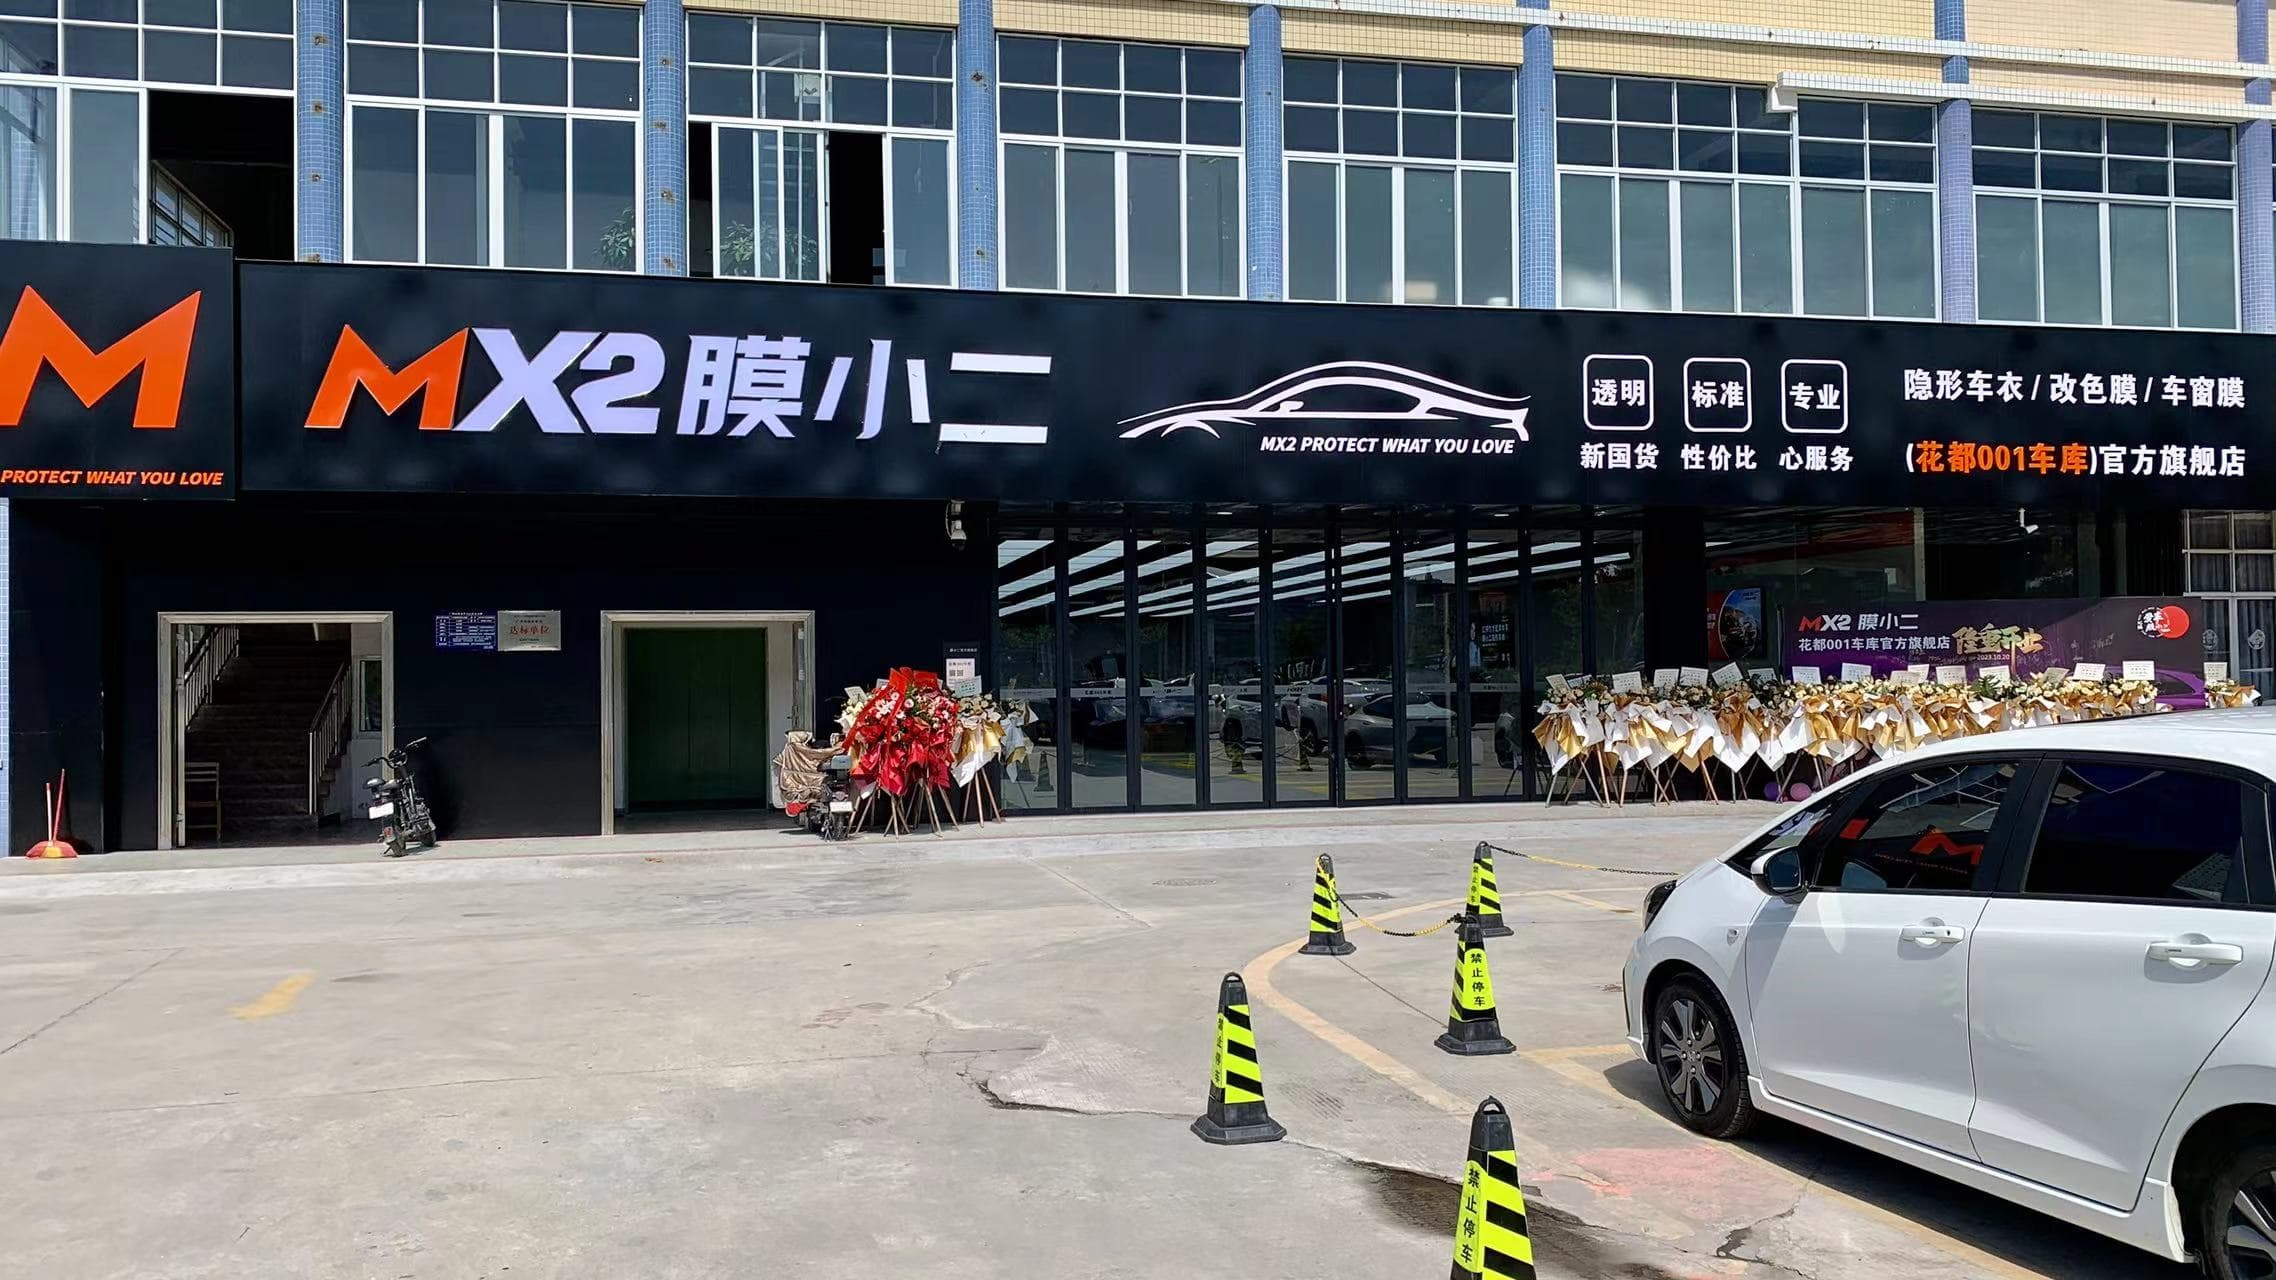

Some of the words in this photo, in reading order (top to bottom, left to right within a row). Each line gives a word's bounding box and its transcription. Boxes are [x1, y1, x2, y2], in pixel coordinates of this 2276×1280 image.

[0, 285, 201, 428] M
[304, 323, 666, 434] MX2
[676, 334, 1052, 439] 膜小二
[1591, 378, 1646, 407] 透明
[1691, 380, 1745, 408] 标准
[1903, 368, 2024, 402] 隐形车衣
[2049, 372, 2138, 406] 改色膜
[2161, 374, 2246, 408] 车窗膜
[1789, 382, 1841, 410] 专业
[1260, 436, 1297, 451] MX2
[1301, 437, 1379, 453] PROTECT
[1382, 438, 1431, 453] WHAT
[1435, 439, 1469, 453] YOU
[1471, 439, 1515, 454] LOVE
[1580, 442, 1659, 470] 新国货
[1680, 443, 1758, 471] 性价比
[1778, 445, 1854, 472] 心服务
[0, 470, 82, 484] PROTECT
[86, 471, 136, 485] WHAT
[140, 472, 175, 485] YOU
[179, 472, 224, 486] LOVE
[1798, 614, 1852, 631] MX2
[1857, 612, 1919, 631] 膜小二
[1798, 635, 1951, 651] 花都001车库官方旗舰店
[1471, 952, 1486, 1007] 禁止停车
[1460, 1167, 1480, 1264] 禁止停车
